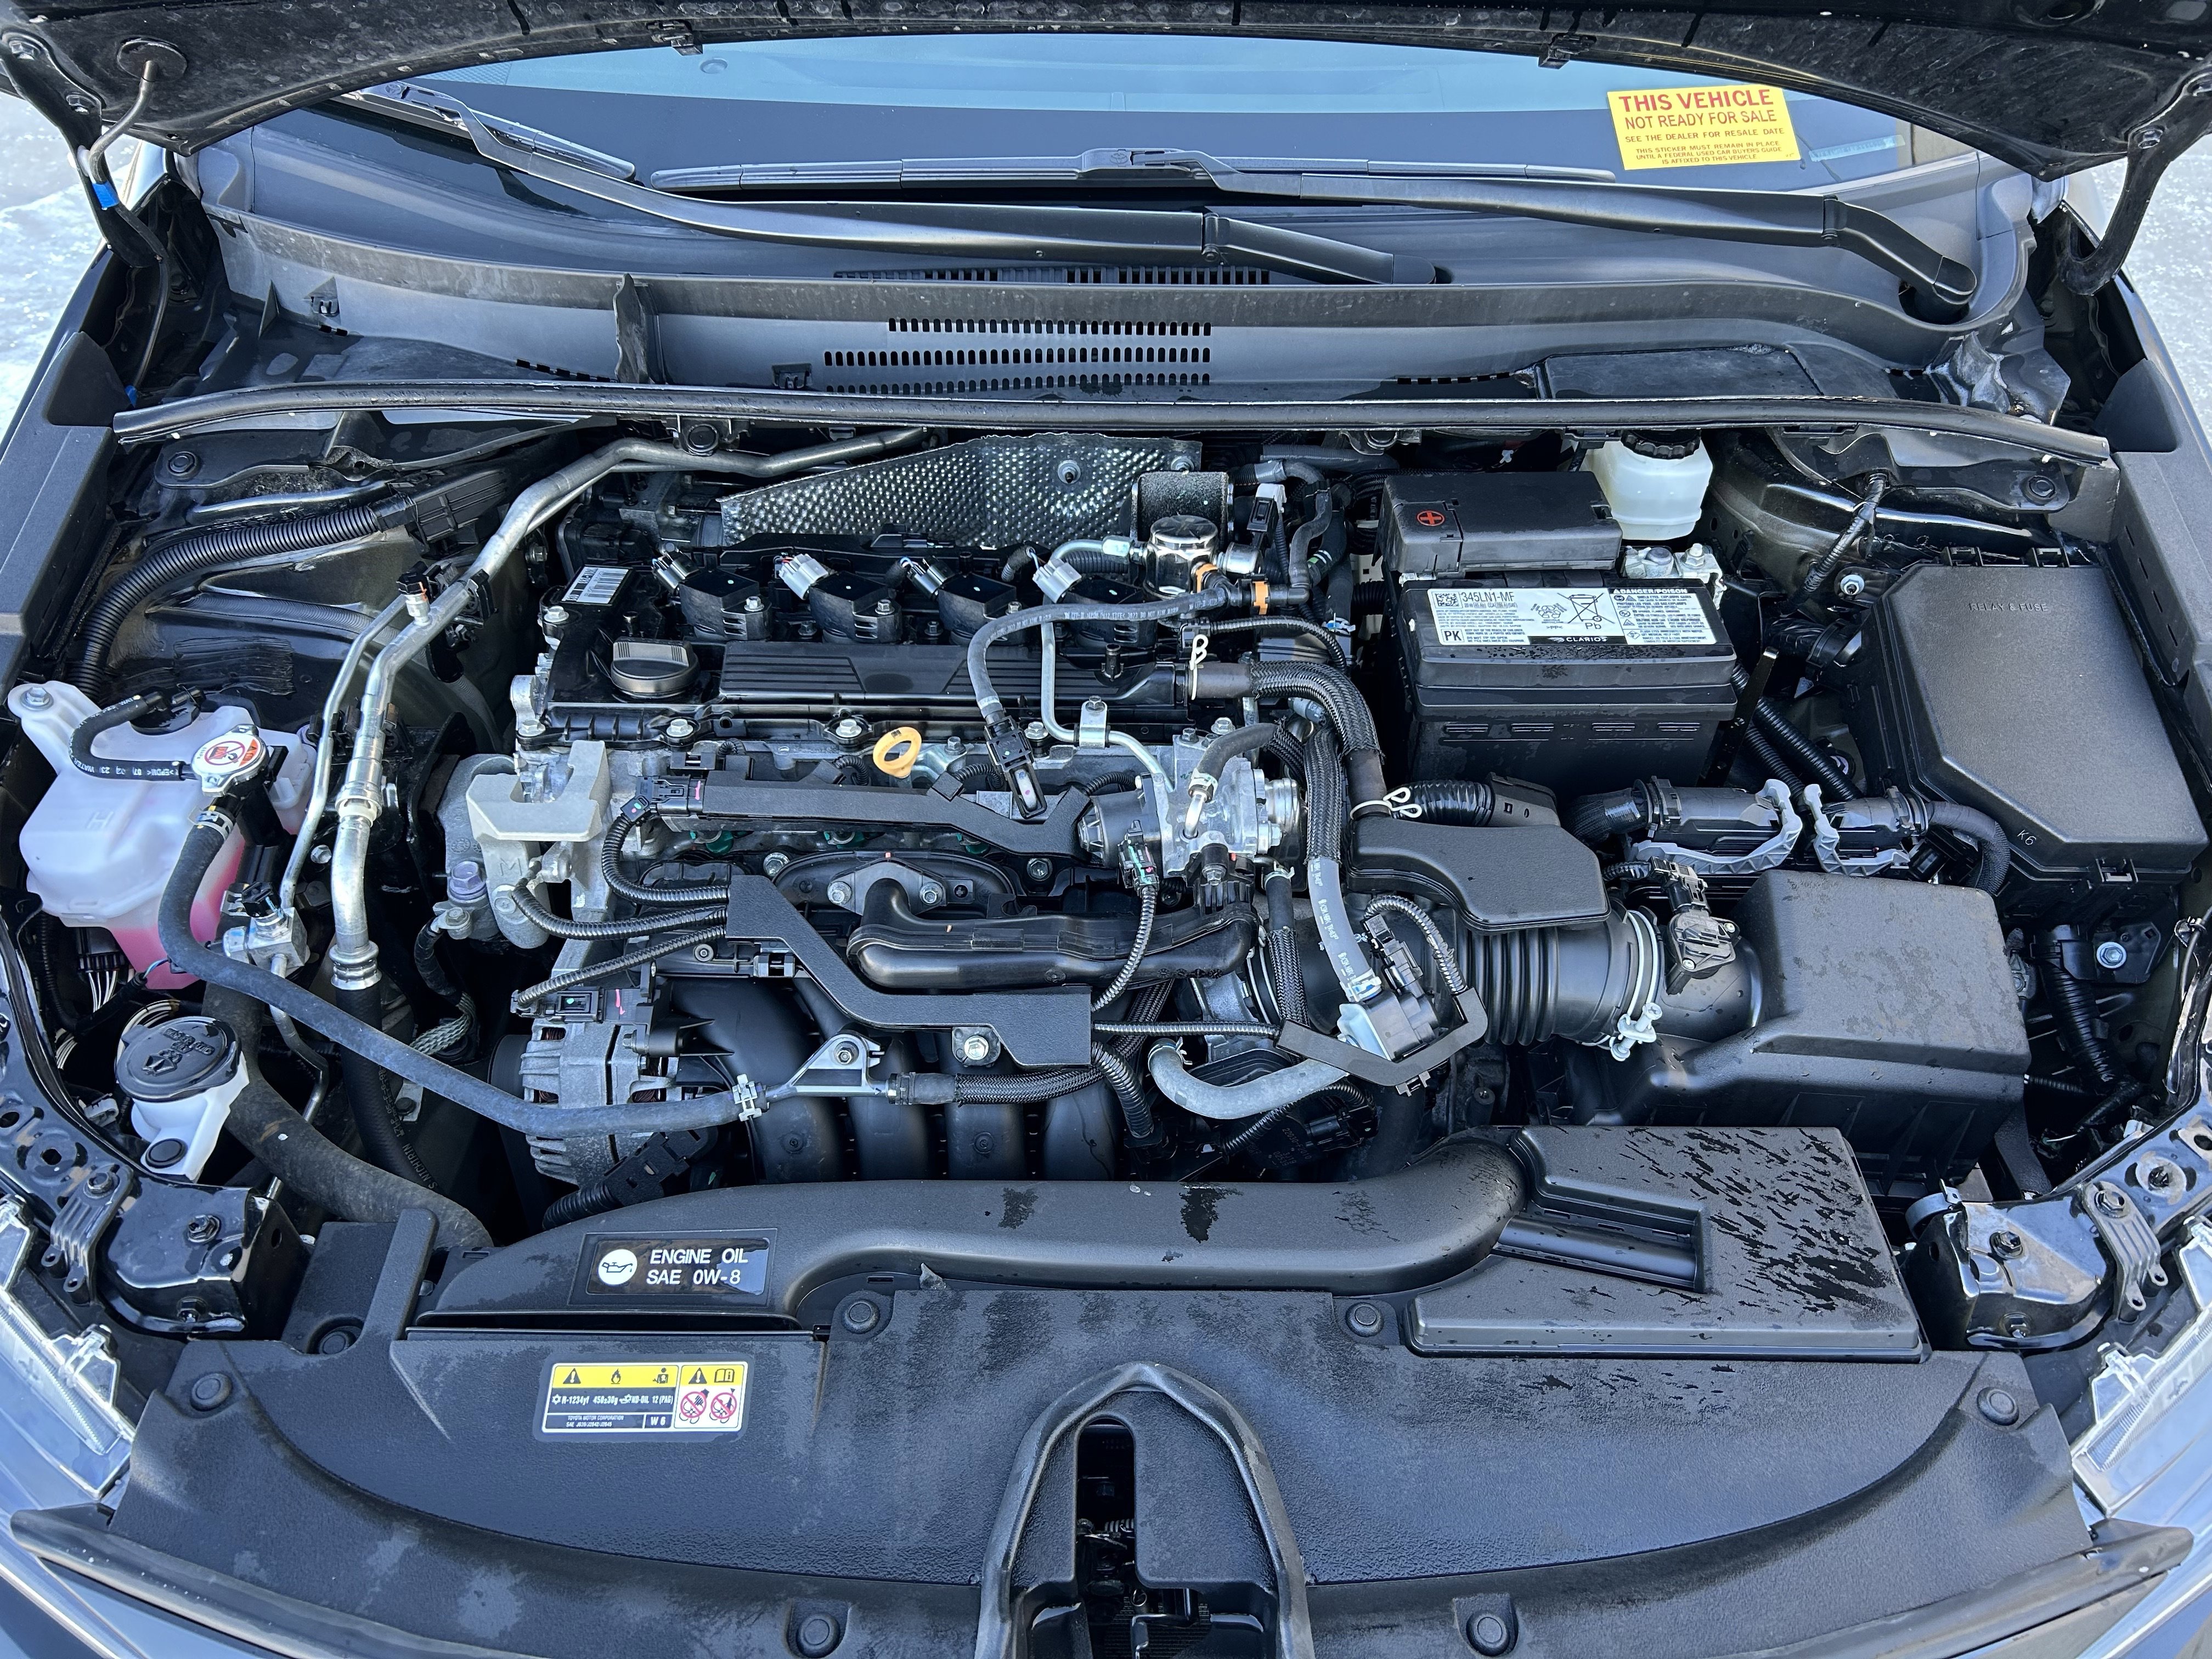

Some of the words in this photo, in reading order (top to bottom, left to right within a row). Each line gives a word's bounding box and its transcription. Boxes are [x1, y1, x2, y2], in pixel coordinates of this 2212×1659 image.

[1618, 94, 1672, 112] THIS
[1676, 89, 1773, 109] VEHICLE
[1625, 116, 1652, 129] NOT
[1658, 112, 1704, 128] READY
[1709, 111, 1738, 125] FOR
[1741, 109, 1777, 123] SALE
[1461, 591, 1515, 602] 345LN1-MF
[1968, 602, 2004, 611] RELAY
[2019, 602, 2049, 611] FUSE
[1444, 630, 1462, 641] PK
[2017, 830, 2036, 845] K6
[1282, 1127, 1312, 1159] 22030-F2010
[650, 1249, 712, 1265] ENGINE
[721, 1248, 748, 1264] OIL
[646, 1269, 682, 1285] SAE
[693, 1269, 741, 1285] 0W-8
[652, 1396, 658, 1404] 12
[651, 1417, 659, 1425] W
[661, 1416, 666, 1425] 6
